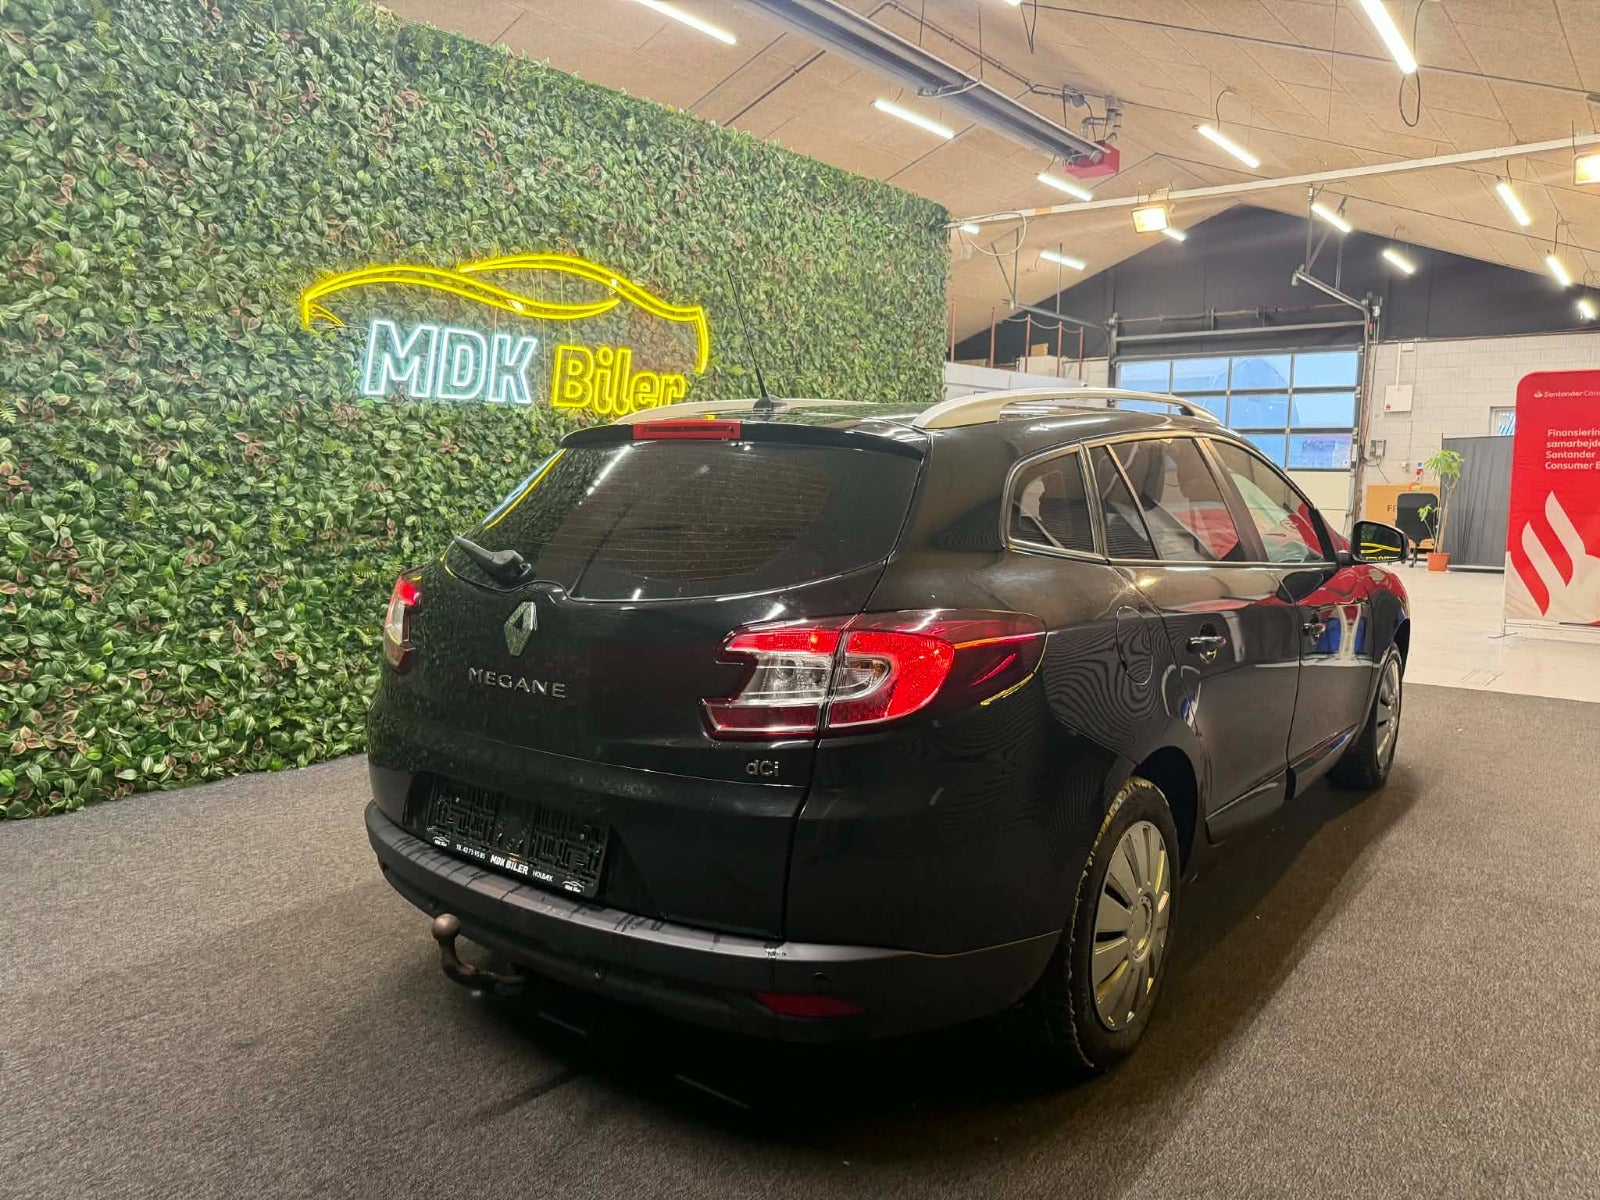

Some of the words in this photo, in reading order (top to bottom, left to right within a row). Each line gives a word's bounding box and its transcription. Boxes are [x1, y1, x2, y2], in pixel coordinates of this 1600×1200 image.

[361, 319, 539, 405] MDK
[550, 343, 687, 417] Biler
[1546, 439, 1600, 449] samarbejd
[1545, 450, 1596, 459] Santander
[1544, 461, 1594, 470] Consumer
[468, 667, 567, 699] MEGANE
[745, 758, 780, 777] dCi
[505, 859, 529, 876] BILER
